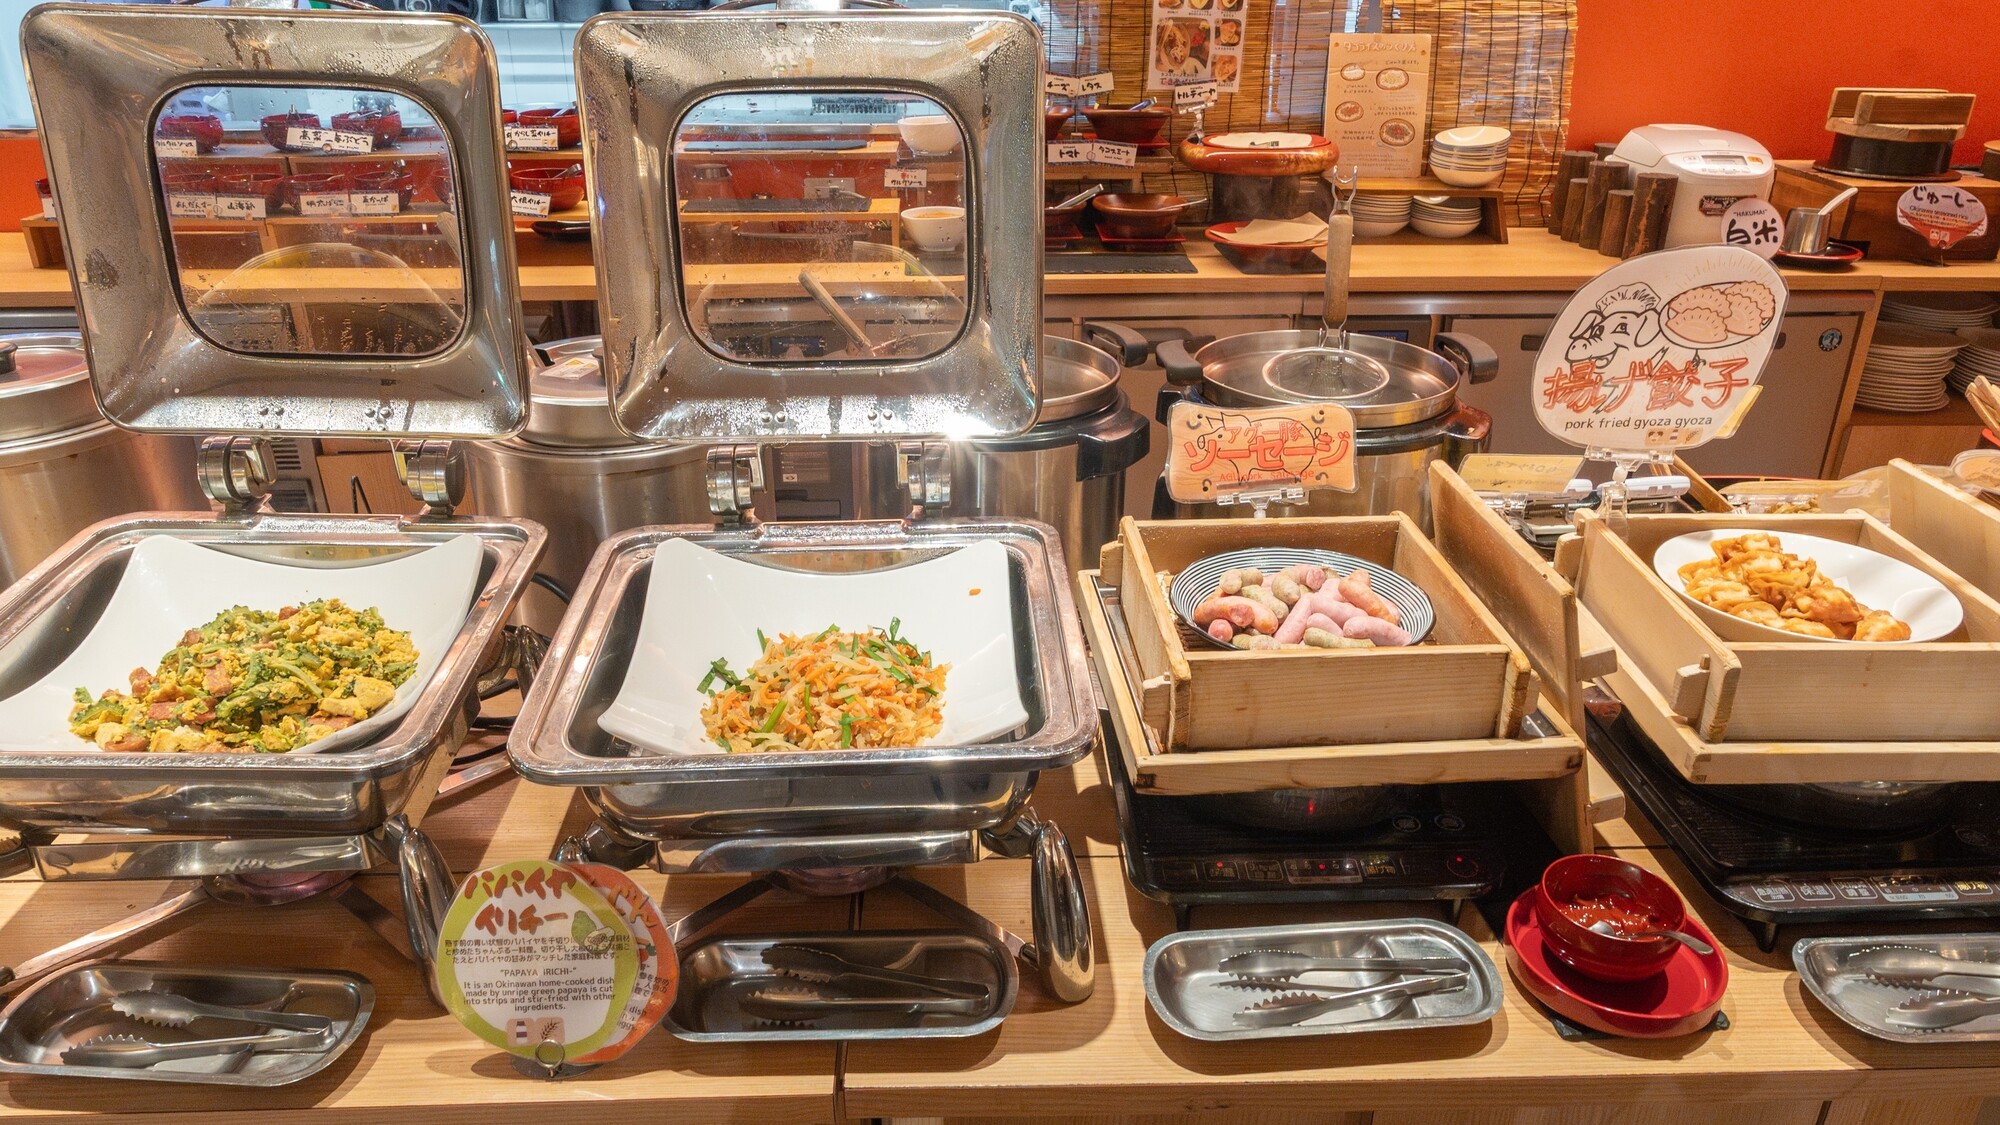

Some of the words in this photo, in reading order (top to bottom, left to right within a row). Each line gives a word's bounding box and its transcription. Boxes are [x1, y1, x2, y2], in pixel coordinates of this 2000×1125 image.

[1343, 41, 1416, 53] タコライスのつくり方
[1047, 81, 1070, 91] チーズ
[1081, 81, 1102, 91] レタス
[1177, 88, 1216, 100] トルティーヤ
[1059, 148, 1080, 159] トマト
[1913, 186, 1978, 208] じゅーしー
[1726, 218, 1778, 245] 白米
[1543, 357, 1749, 413] 揚げ餃子
[1564, 417, 1595, 431] pork
[1599, 416, 1630, 428] fried
[1634, 418, 1671, 430] gyoza
[1675, 416, 1713, 430] gyoza
[1224, 421, 1304, 444] アグー豚
[1184, 431, 1350, 472] ソーセージ
[464, 867, 577, 900] パパイヤ
[475, 903, 569, 936] イリチー
[501, 968, 538, 977] "PAPAYA
[464, 981, 471, 989] It
[473, 981, 481, 989] is
[495, 980, 537, 988] Okinawan
[539, 978, 595, 987] home-cooked
[597, 977, 615, 986] dish
[466, 989, 487, 997] made
[489, 989, 499, 998] by
[502, 988, 529, 998] unripe
[531, 988, 556, 998] green
[558, 987, 587, 997] papaya
[590, 985, 597, 993] is
[599, 985, 613, 993] cut
[464, 997, 481, 1005] into
[482, 996, 508, 1006] strips
[510, 995, 526, 1004] and
[527, 994, 569, 1003] stir-fried
[571, 993, 591, 1001] with
[593, 992, 616, 1001] other
[514, 1003, 566, 1013] ingredients.
